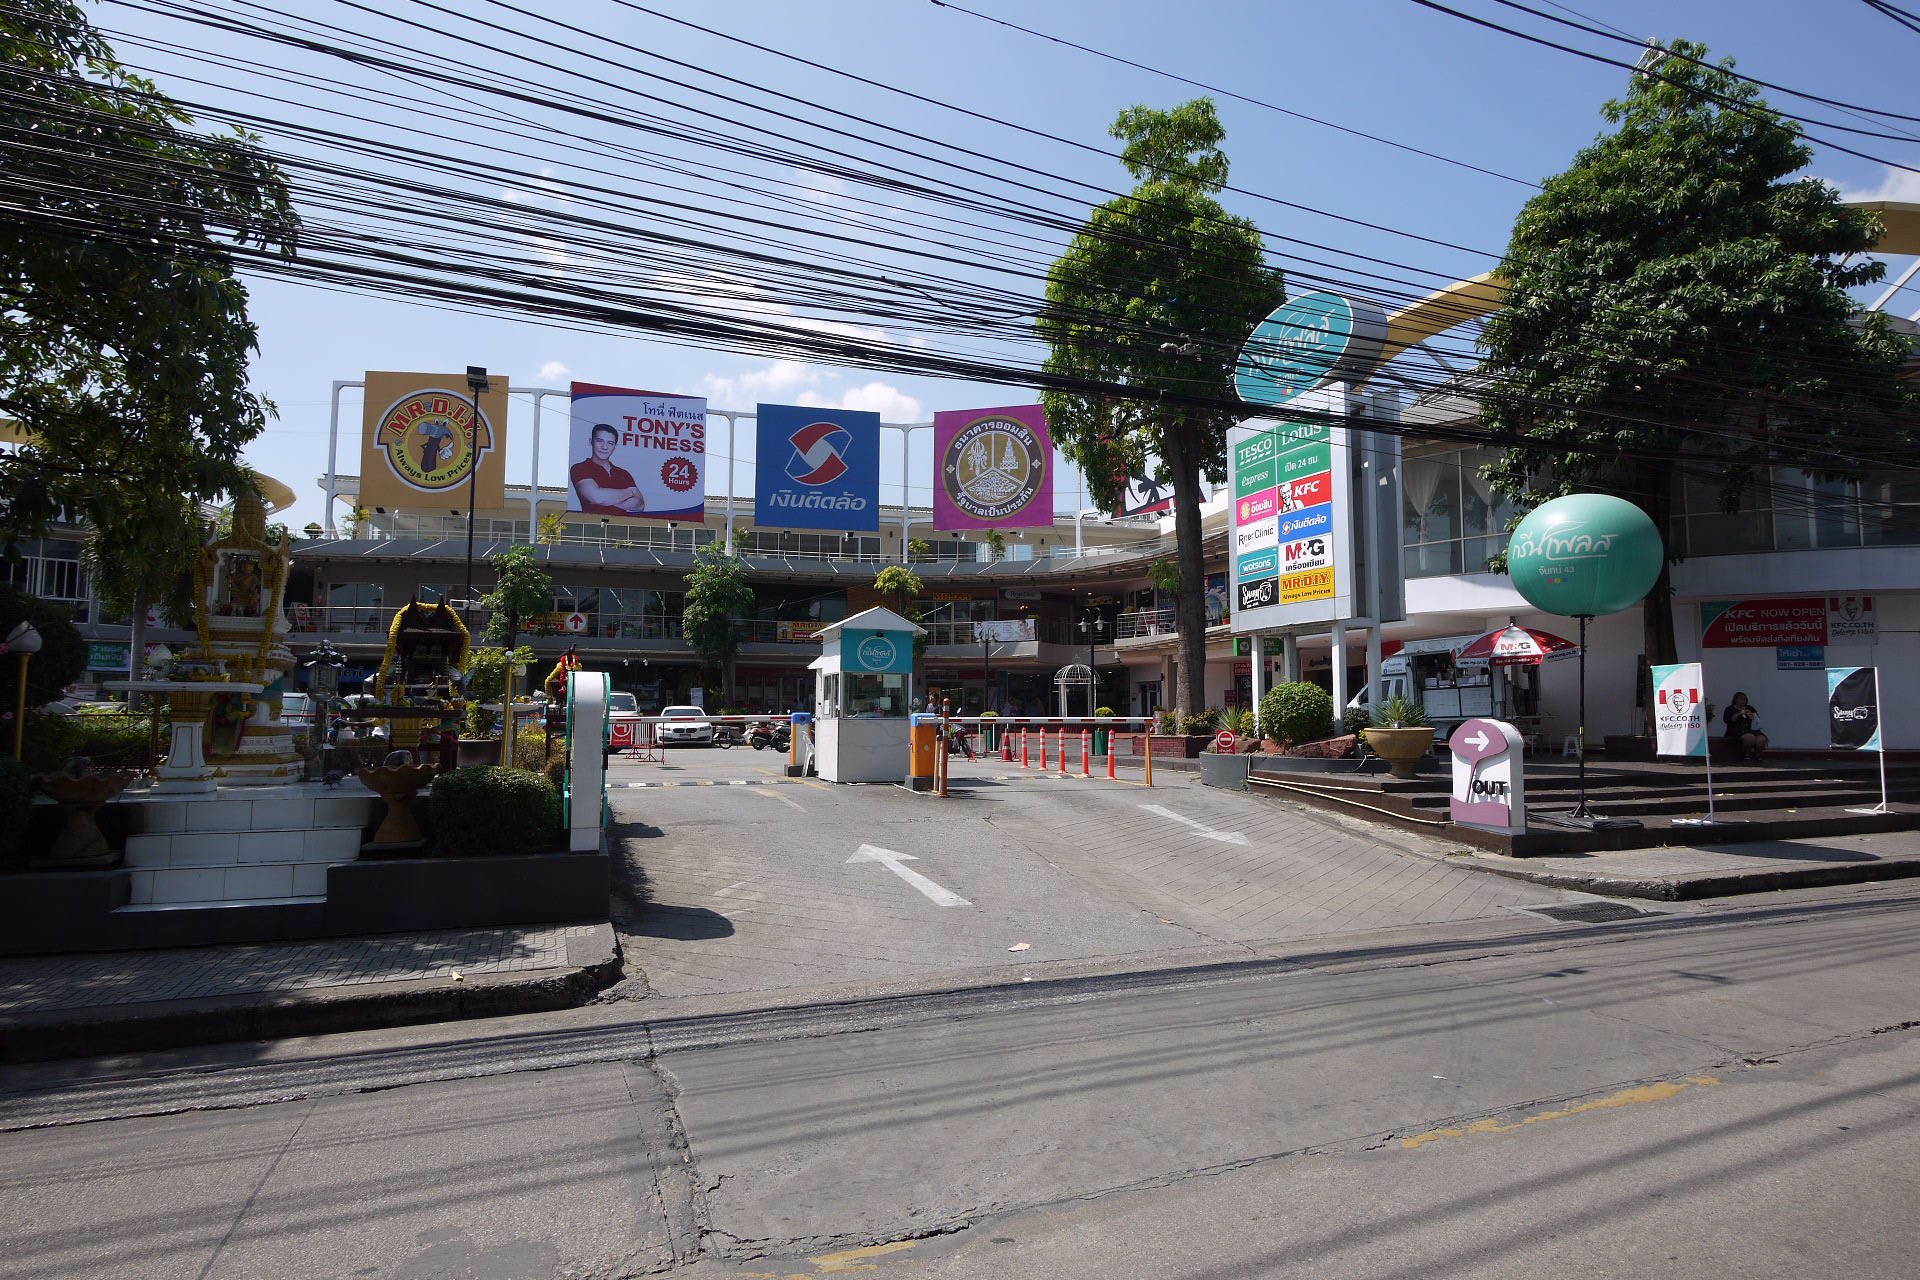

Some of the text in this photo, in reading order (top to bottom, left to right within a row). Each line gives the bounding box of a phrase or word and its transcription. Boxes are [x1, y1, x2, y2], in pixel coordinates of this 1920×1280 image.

[643, 402, 704, 421] โทนี่ ฟิตเนส
[623, 415, 705, 439] TONY'S
[954, 421, 1033, 450] ธนาคารออมสิน
[623, 433, 705, 454] FITNESS
[1239, 424, 1323, 461] TESCO Lotus
[395, 447, 472, 482] Always Low Prices
[669, 463, 690, 479] 24
[1284, 460, 1297, 473] เปิด
[1298, 459, 1307, 469] 24
[668, 477, 690, 486] Hours
[1241, 470, 1269, 487] express
[1293, 480, 1320, 498] KFC
[769, 489, 867, 511] เงินติดล้อ
[956, 487, 1034, 517] รัฐบาลเป็นประกัน
[1251, 498, 1273, 514] ออมสิน
[1291, 513, 1327, 530] เงินติดล้อ
[1255, 525, 1274, 539] Clinic
[1285, 538, 1325, 562] M&G
[1242, 559, 1271, 571] watsons
[1285, 558, 1325, 572] เครื่องเขียน
[1725, 607, 1825, 619] KFC NOW OPEN
[1725, 617, 1823, 632] เปิดบริการแล้ววันนี้
[1472, 780, 1508, 795] OUT
